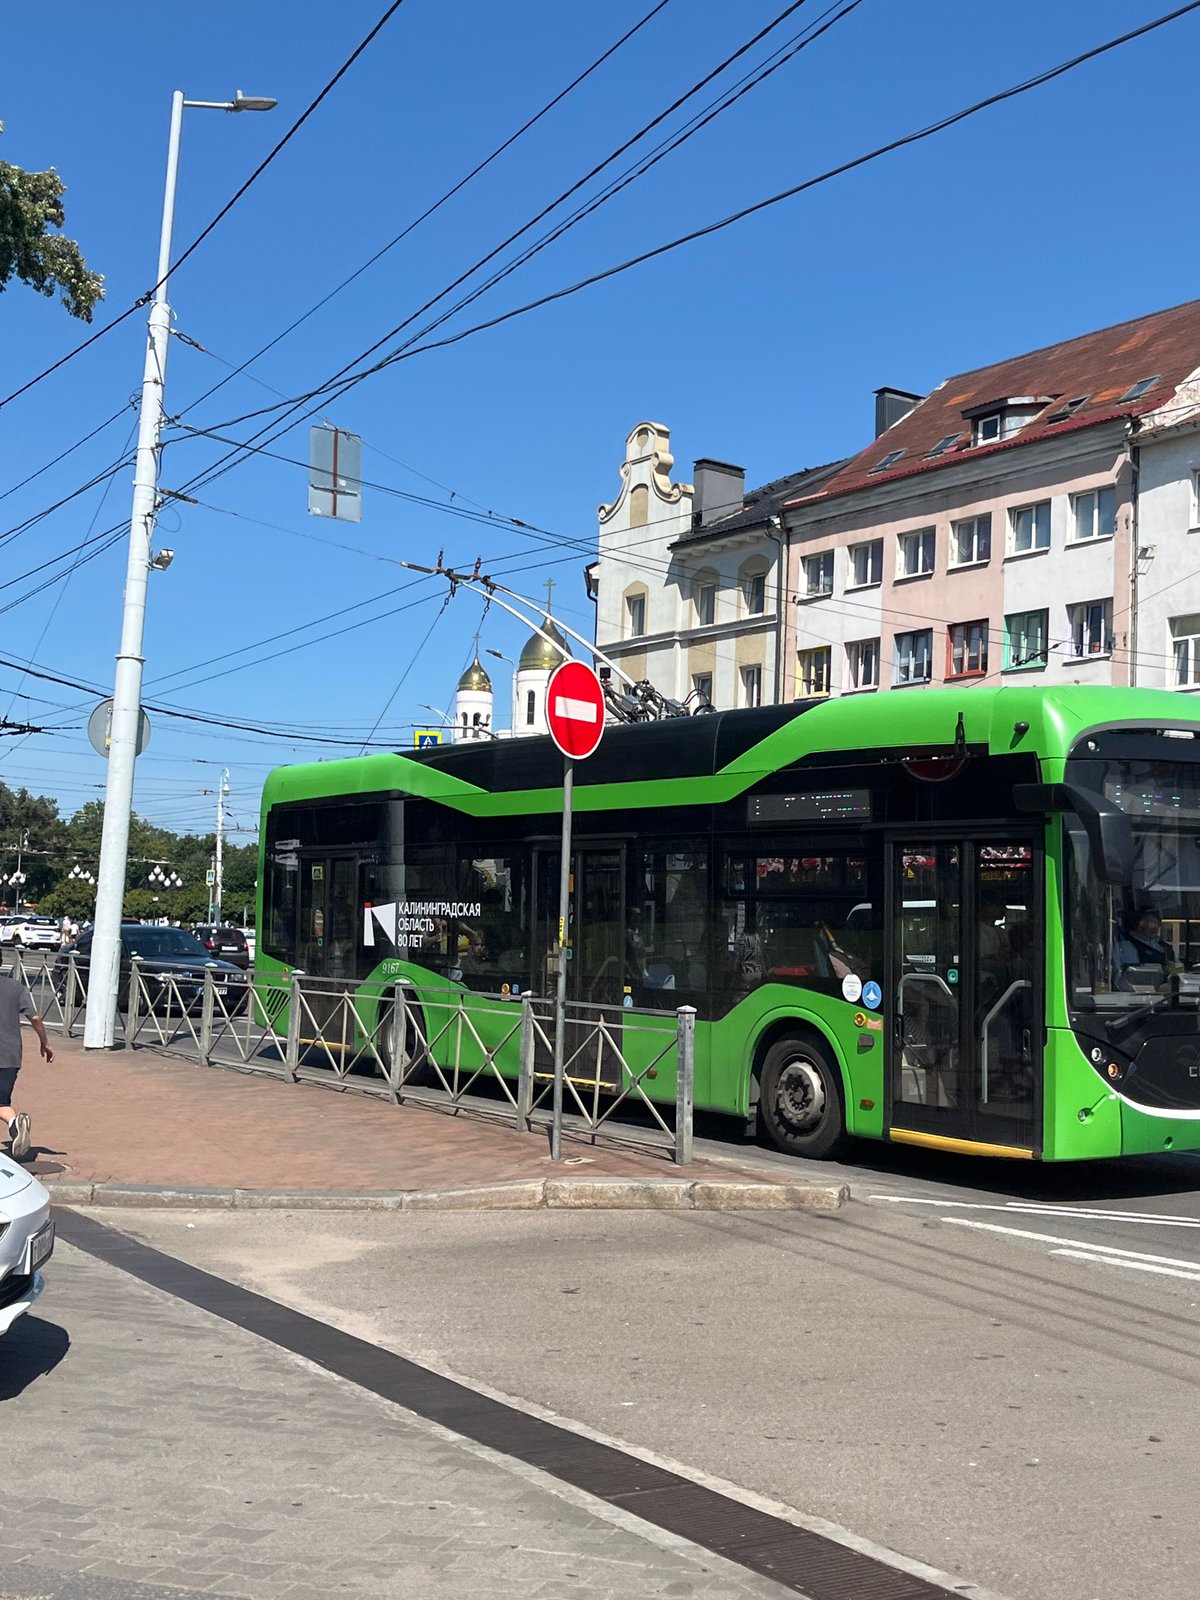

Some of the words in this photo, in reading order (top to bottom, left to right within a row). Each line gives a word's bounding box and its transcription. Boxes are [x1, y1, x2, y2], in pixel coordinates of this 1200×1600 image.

[398, 902, 481, 918] КАЛИНИНГРАДСКАЯ
[398, 918, 435, 932] ОБЛАСТЬ
[398, 934, 408, 947] 80
[408, 934, 423, 948] ЛЕТ
[382, 962, 400, 974] 9167
